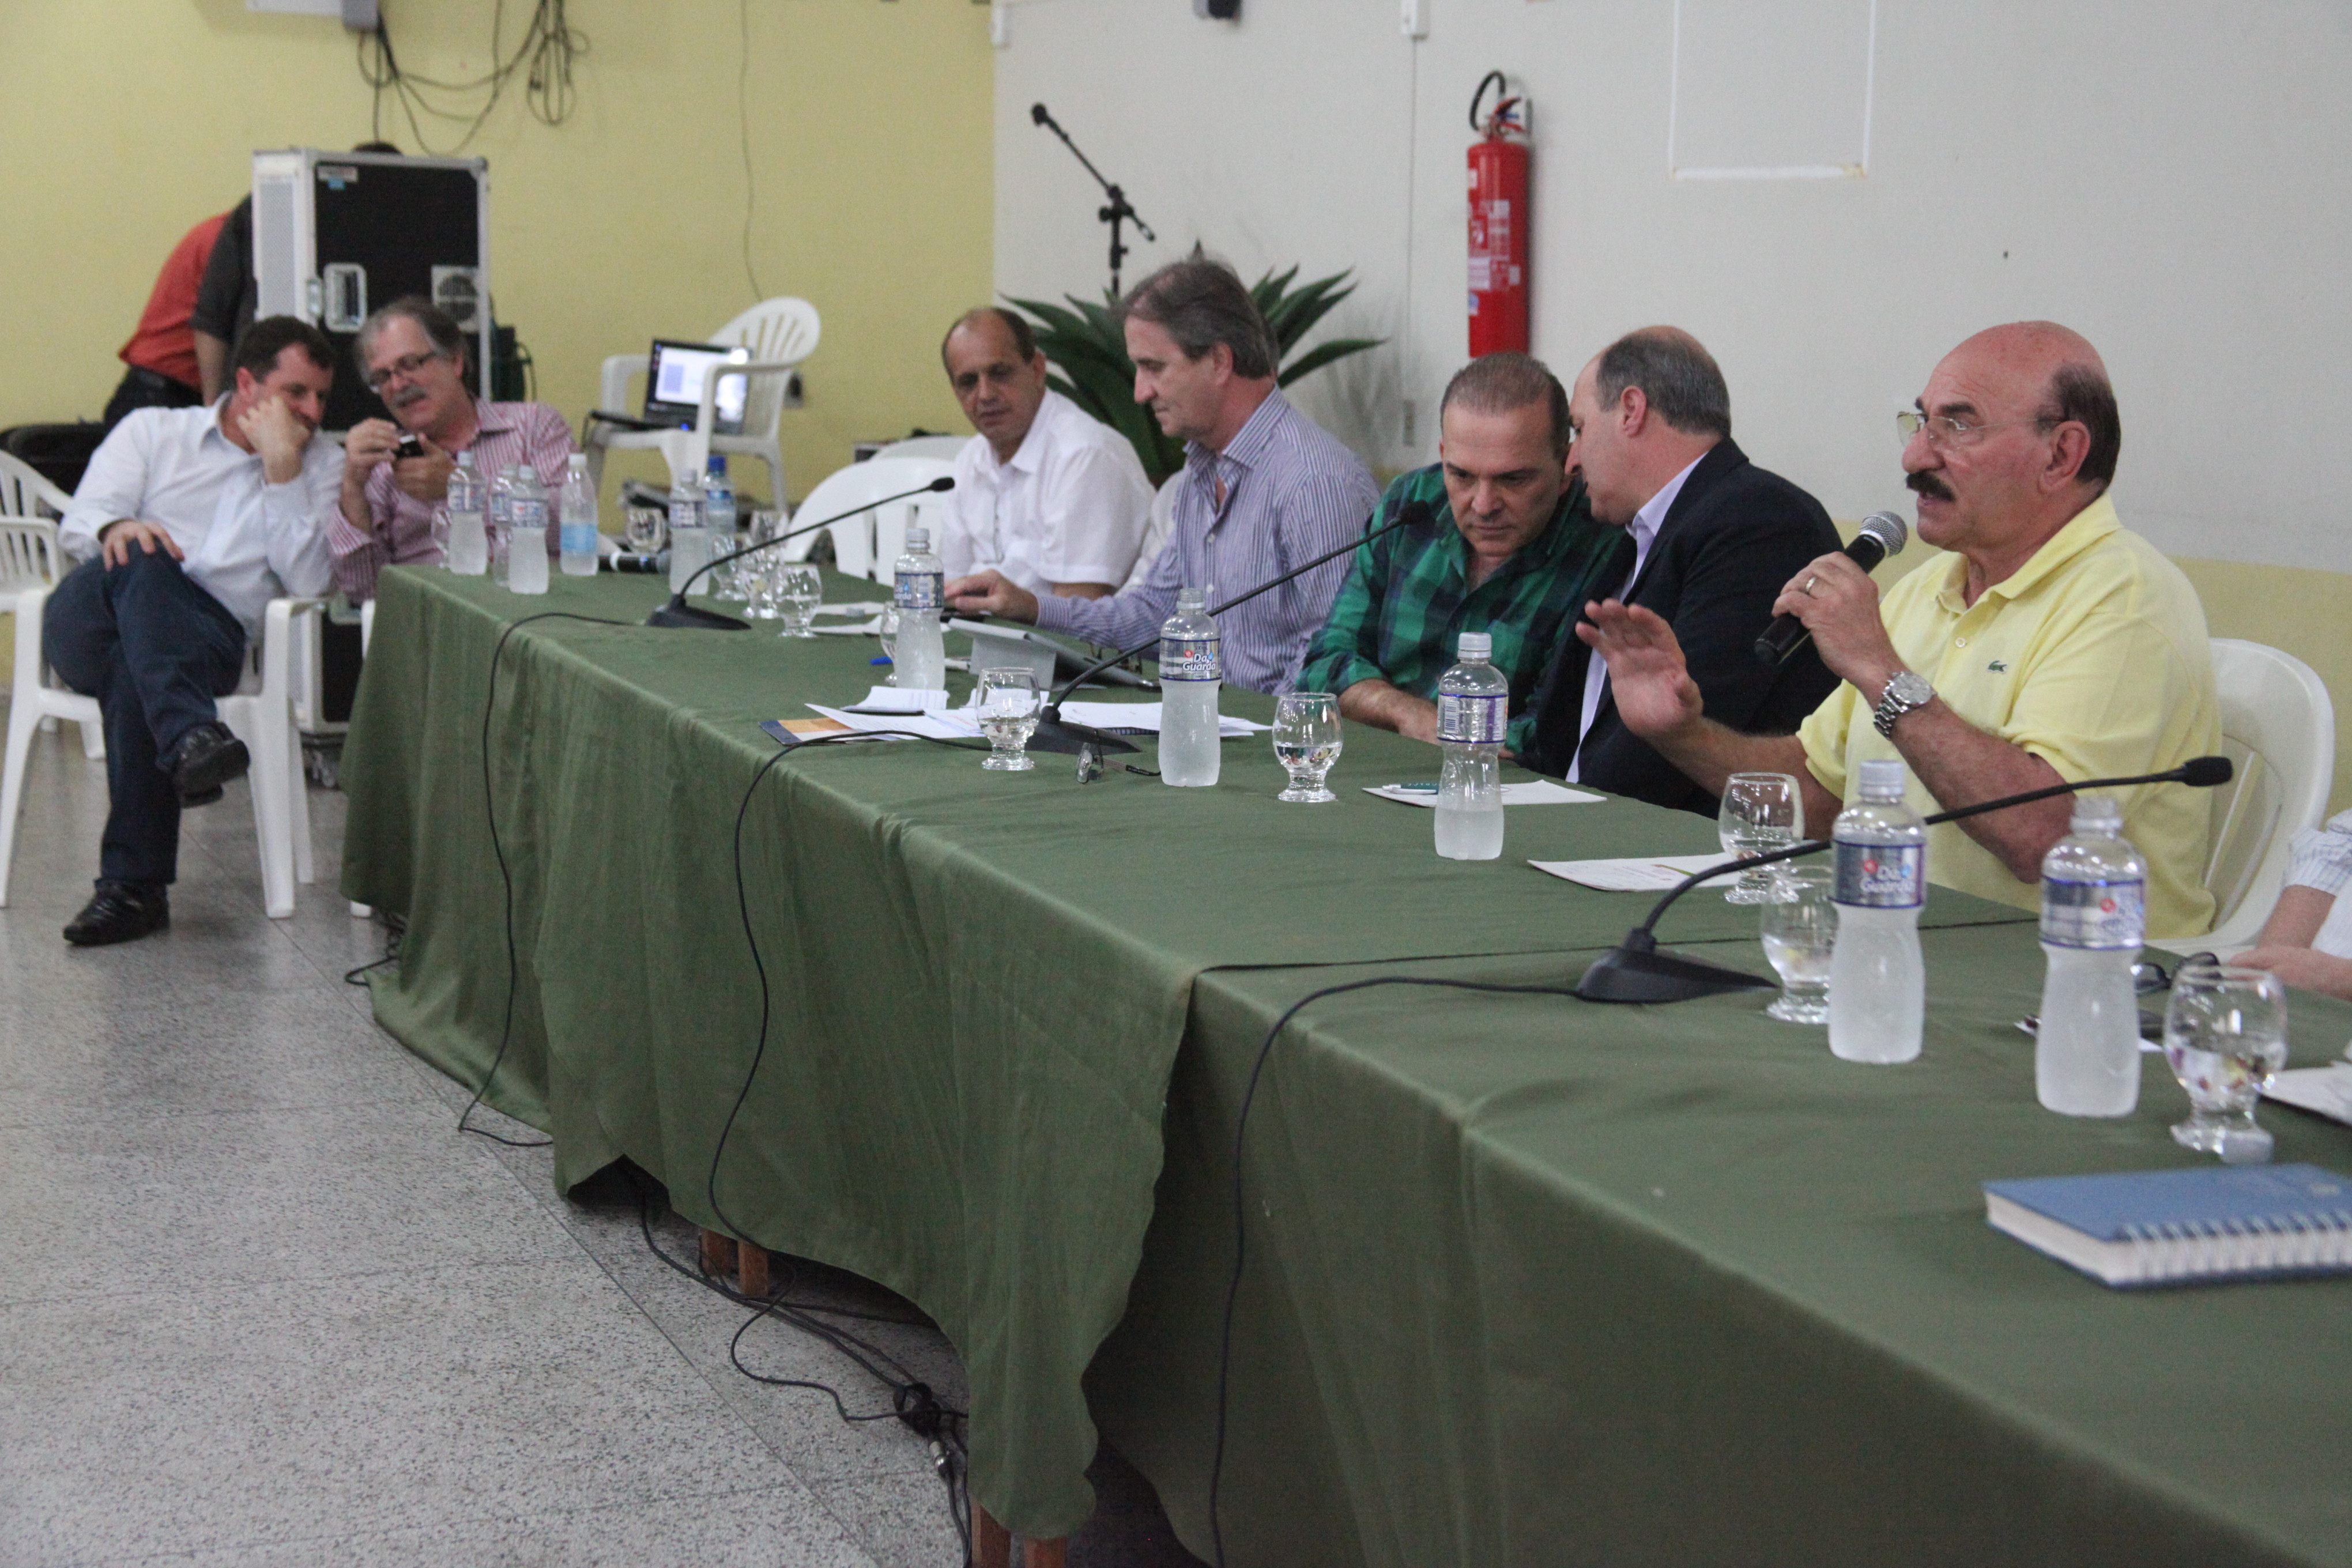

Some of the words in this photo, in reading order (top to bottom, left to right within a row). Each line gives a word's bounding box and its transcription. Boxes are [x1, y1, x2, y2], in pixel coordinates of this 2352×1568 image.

[1193, 653, 1208, 662] Da
[1182, 661, 1216, 672] Guarda
[1877, 865, 1902, 881] Da
